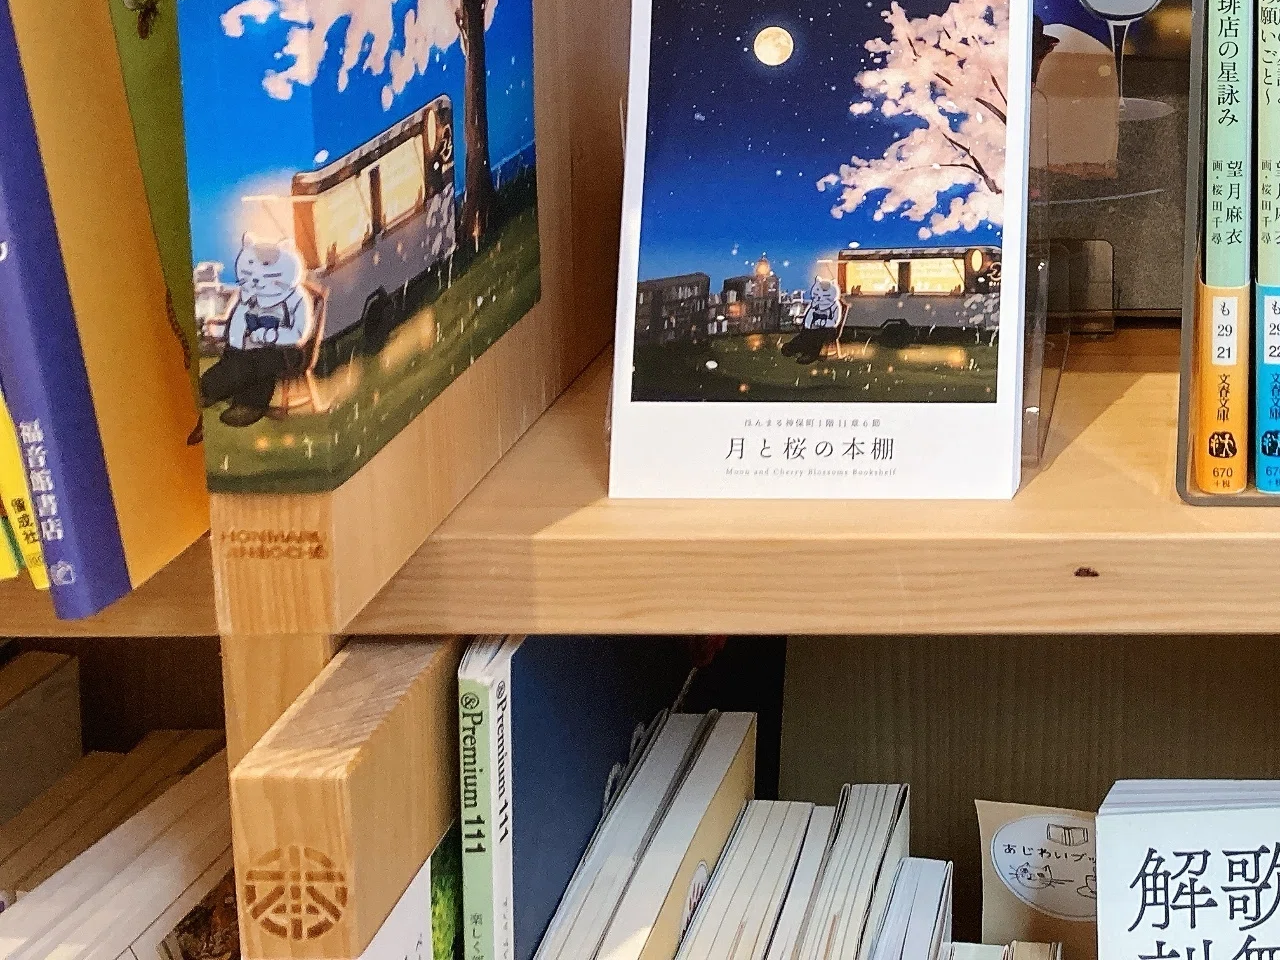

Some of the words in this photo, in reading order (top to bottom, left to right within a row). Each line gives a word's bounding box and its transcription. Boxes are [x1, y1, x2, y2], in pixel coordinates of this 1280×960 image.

[1226, 160, 1243, 245] 望月麻衣
[1220, 301, 1230, 316] も
[1217, 324, 1233, 337] 29
[1216, 346, 1232, 358] 21
[1216, 373, 1231, 423] 文春文庫
[725, 437, 895, 460] 月と桜の本棚
[773, 468, 804, 477] Cherry
[807, 468, 849, 476] Blossoms
[852, 468, 897, 476] Bookshelf
[1212, 467, 1233, 478] 670
[499, 799, 509, 843] 111
[464, 814, 487, 854] 111
